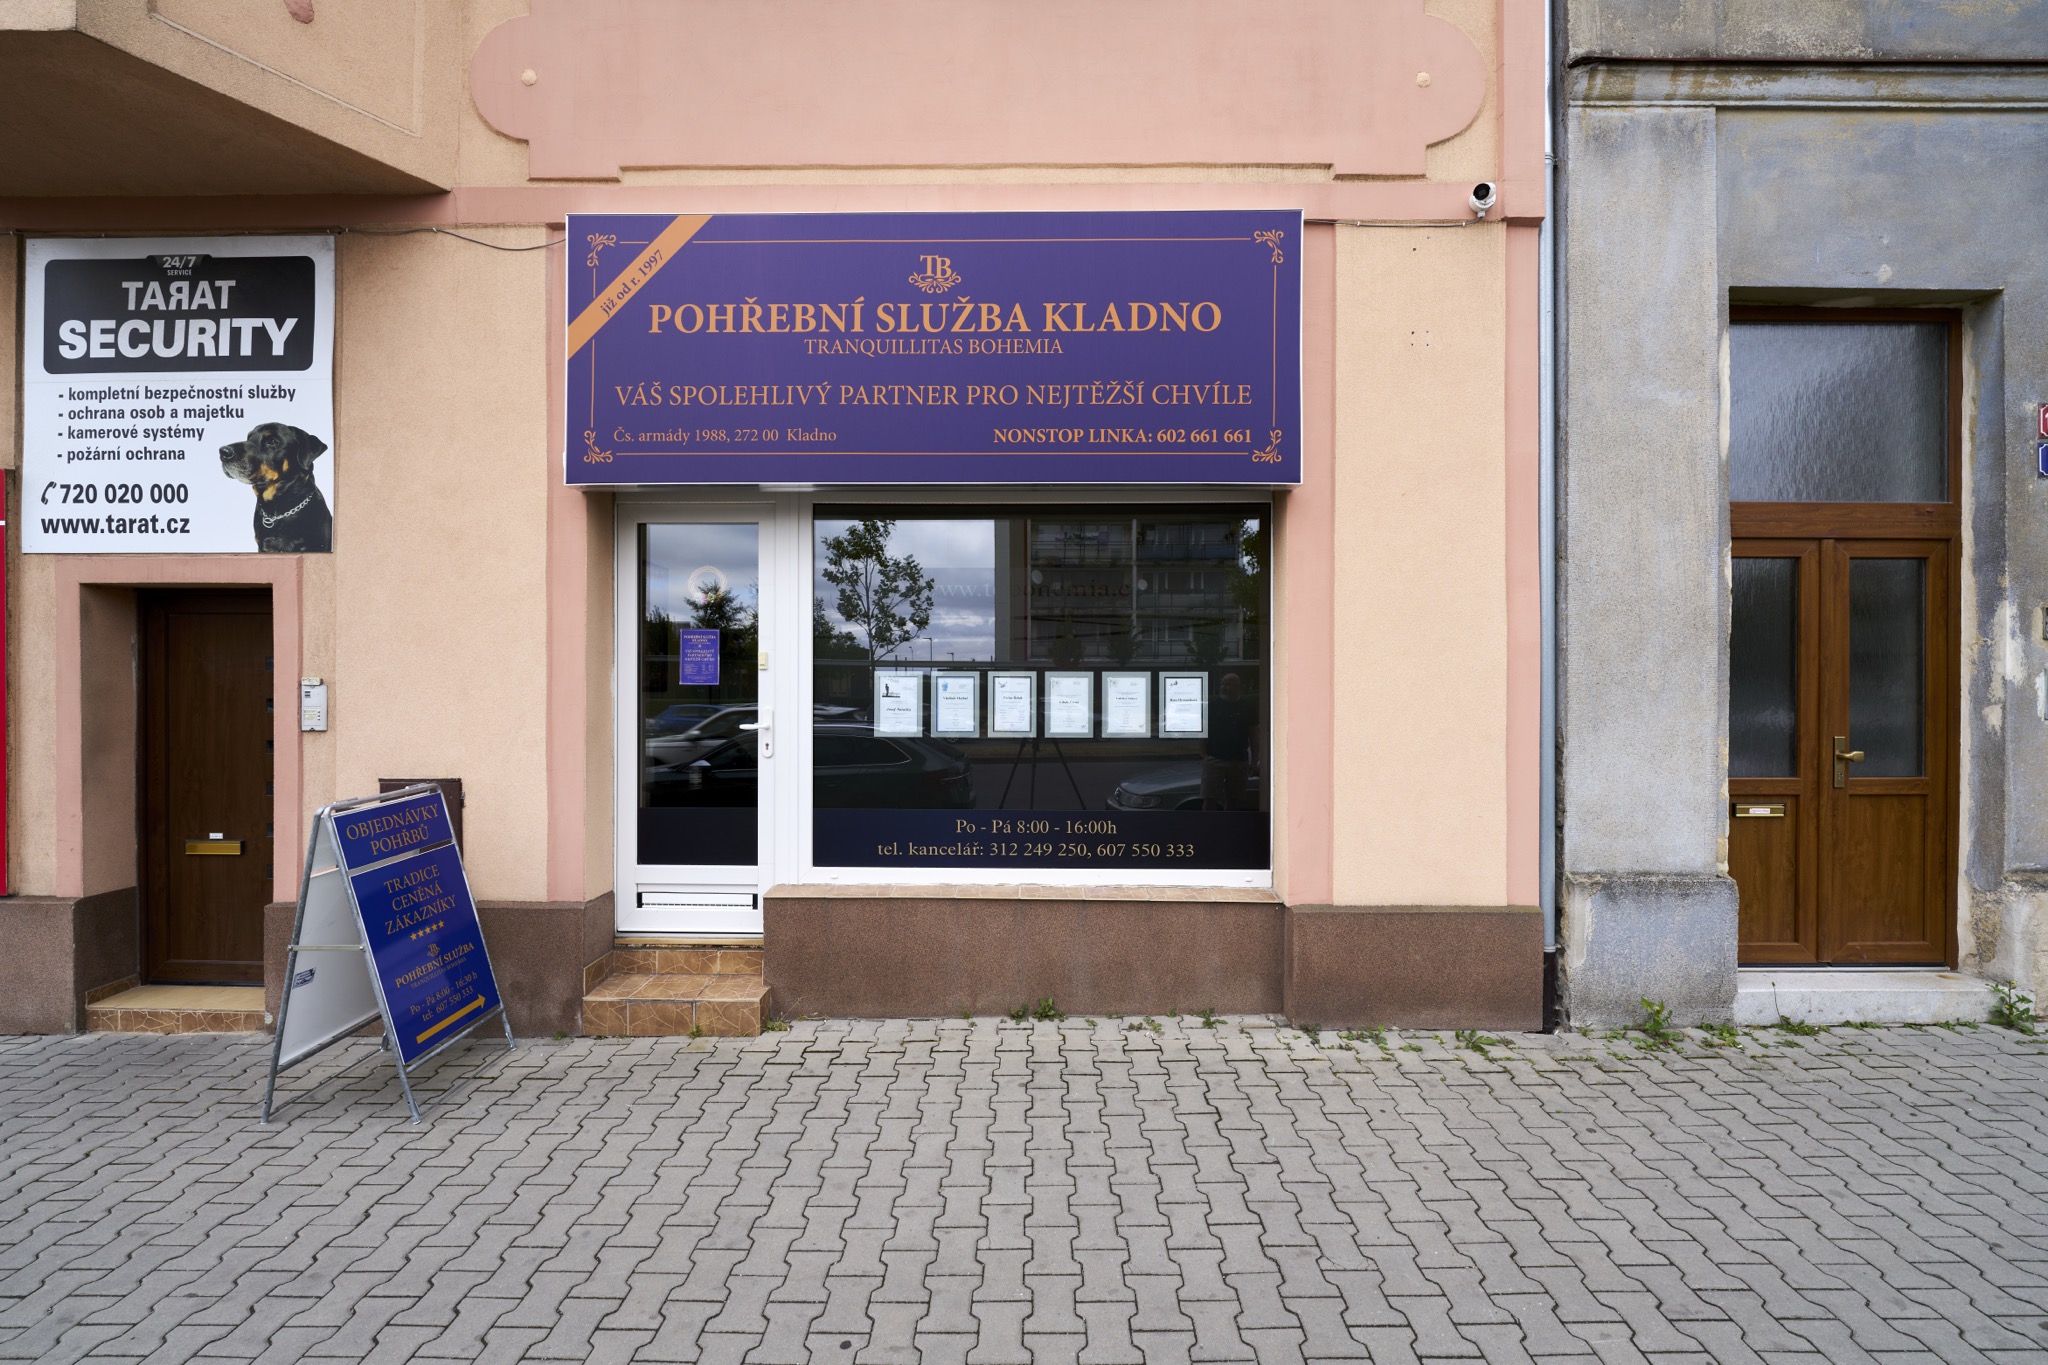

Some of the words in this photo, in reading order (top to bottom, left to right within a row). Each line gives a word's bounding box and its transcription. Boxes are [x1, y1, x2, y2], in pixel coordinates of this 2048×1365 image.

[162, 256, 197, 269] 24/7
[166, 268, 193, 276] SERVICE
[600, 297, 617, 317] již
[617, 282, 631, 300] od
[631, 277, 640, 286] r.
[638, 249, 662, 276] 1997
[649, 296, 864, 333] POHŘEBNÍ
[876, 296, 1031, 332] SLUŽBA
[1043, 302, 1221, 332] KLADNO
[59, 318, 298, 359] SECURITY
[804, 339, 962, 357] TRANQUILLITAS
[969, 339, 1063, 354] BOHEMIA
[69, 385, 139, 403] kompletní
[145, 385, 242, 402] bezpečnostní
[248, 385, 295, 401] služby
[615, 382, 662, 405] VÁŠ
[670, 382, 832, 405] SPOLEHLIVÝ
[840, 385, 959, 405] PARTNER
[967, 385, 1018, 405] PRO
[1026, 381, 1144, 408] NEJTĚŽŠÍ
[1152, 381, 1252, 404] CHVÍLE
[68, 406, 124, 419] ochrana
[130, 405, 165, 419] osob
[170, 409, 178, 418] a
[184, 405, 244, 421] majetku
[68, 425, 138, 439] kamerové
[143, 424, 204, 441] systémy
[614, 426, 634, 441] Čs.
[639, 428, 690, 445] armády
[696, 430, 730, 442] 1988,
[735, 430, 758, 441] 272
[762, 429, 778, 441] 00
[787, 428, 836, 441] Kladno
[994, 429, 1084, 442] NONSTOP
[1089, 429, 1152, 442] LINKA:
[1157, 429, 1185, 442] 602
[1190, 429, 1217, 442] 661
[1224, 429, 1251, 442] 661
[68, 446, 120, 464] požární
[126, 447, 185, 460] ochrana
[60, 484, 97, 503] 720
[105, 484, 143, 503] 020
[150, 484, 188, 503] 000
[41, 515, 190, 534] www.tarat.cz
[346, 803, 438, 840] OBJEDNÁVKY
[956, 820, 975, 833] Po
[992, 820, 1010, 833] Pá
[1017, 821, 1049, 833] 8:00
[1067, 821, 1116, 834] 16:00h
[370, 823, 429, 855] POHŘBŮ
[878, 842, 902, 855] tel.
[909, 842, 983, 855] kancelář:
[990, 843, 1017, 855] 312
[1024, 843, 1052, 856] 249
[1058, 844, 1091, 858] 250,
[1097, 844, 1125, 856] 607
[1132, 844, 1160, 856] 550
[1166, 844, 1194, 857] 333
[383, 864, 440, 894] TRADICE
[392, 880, 443, 911] CENĚNÁ
[385, 895, 457, 935] ZÁKAZNÍKY
[395, 955, 443, 988] POHŘEBNÍ
[443, 942, 475, 964] SLUŽBA
[410, 1005, 420, 1015] Po
[425, 995, 435, 1006] Pá
[435, 986, 450, 1000] 8:00
[455, 974, 472, 989] 16:30
[435, 1000, 448, 1013] 607
[449, 993, 461, 1006] 550
[462, 985, 473, 998] 333
